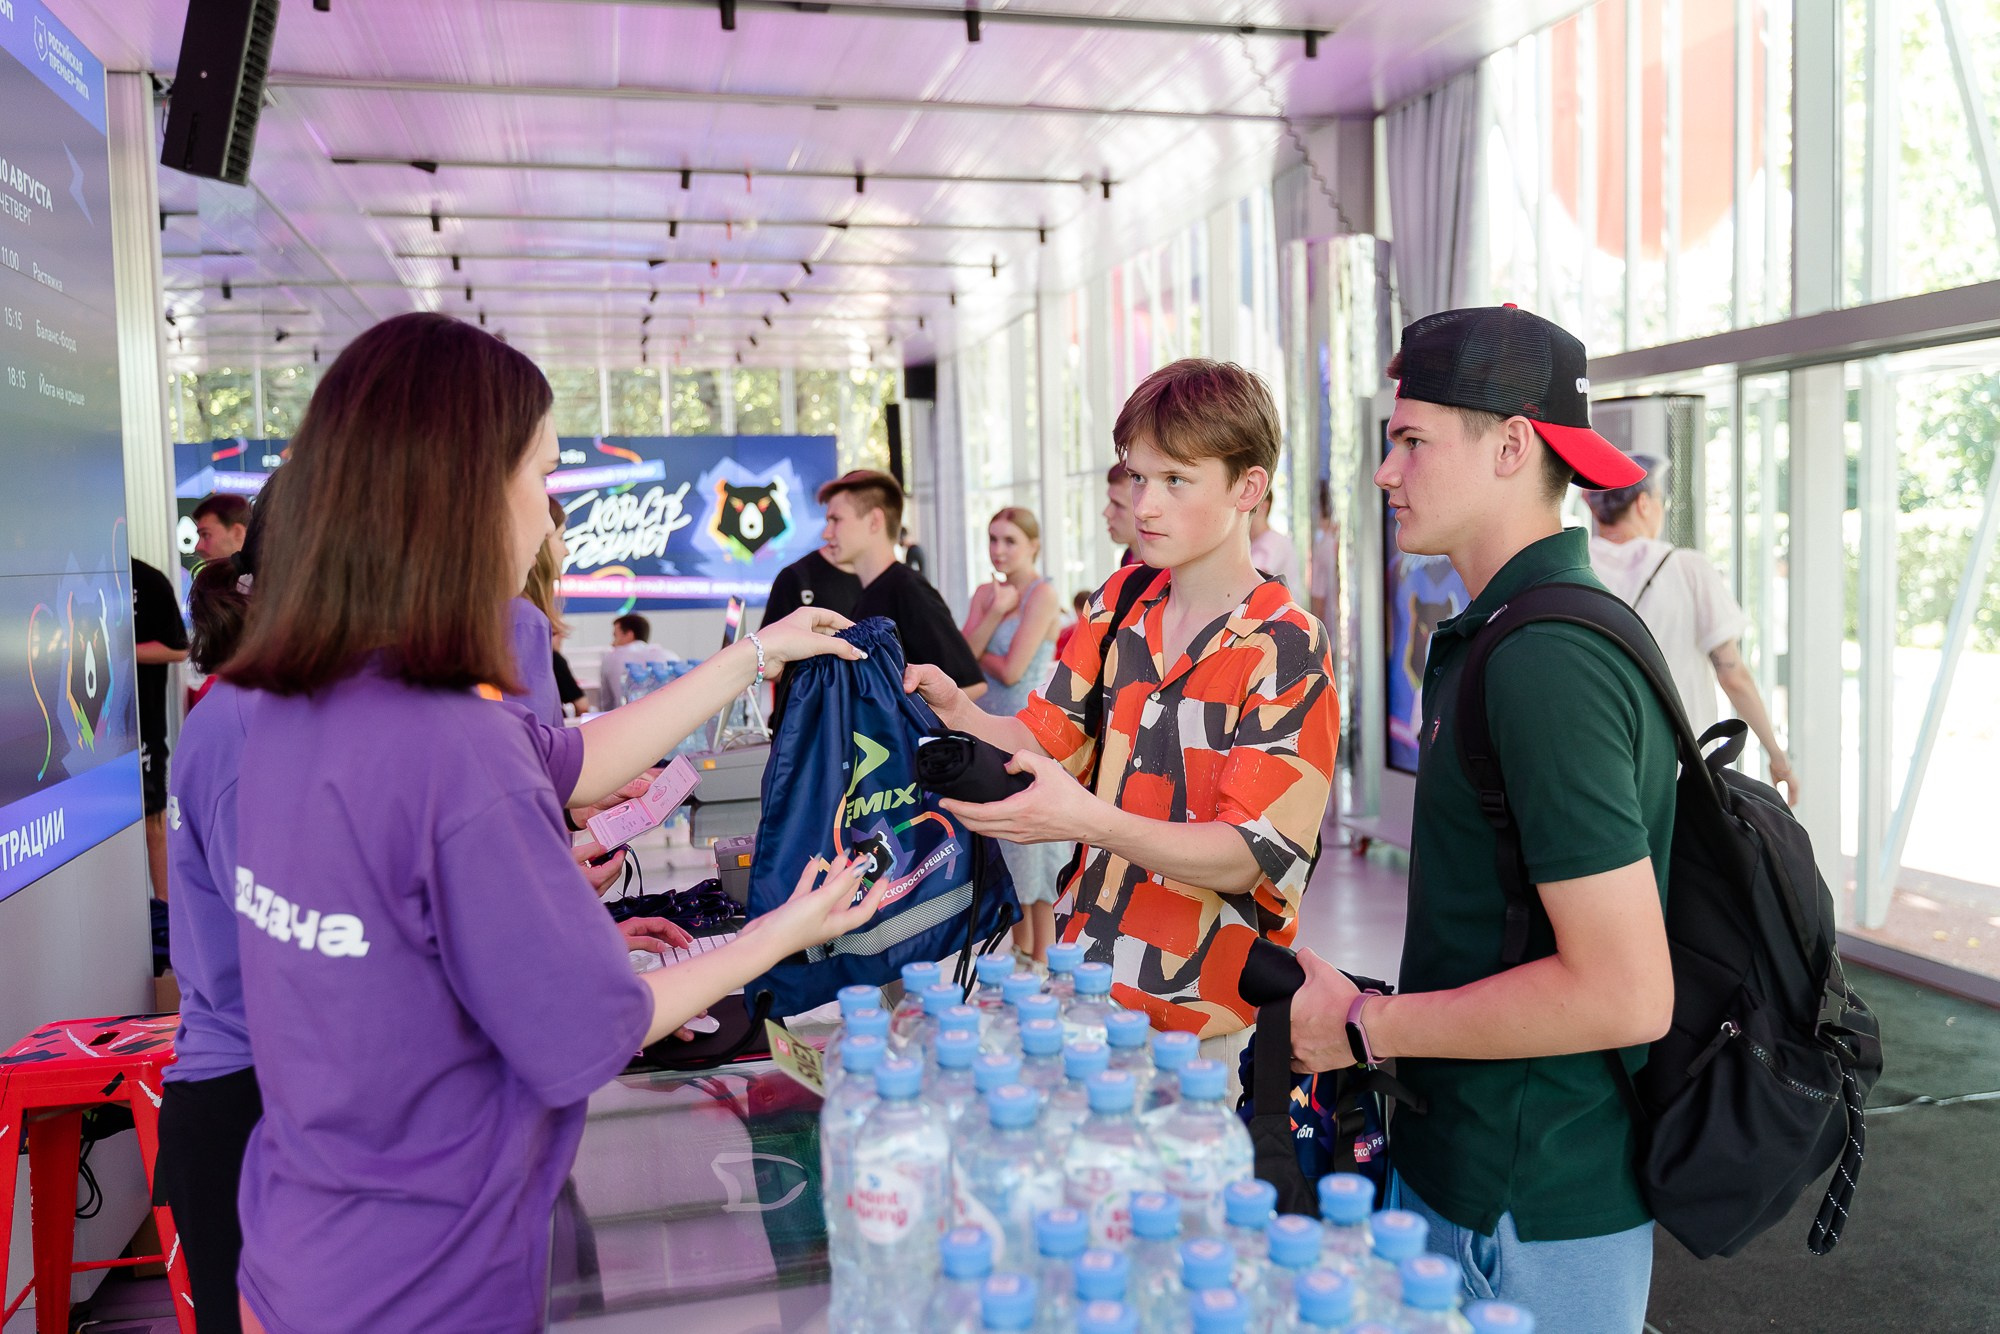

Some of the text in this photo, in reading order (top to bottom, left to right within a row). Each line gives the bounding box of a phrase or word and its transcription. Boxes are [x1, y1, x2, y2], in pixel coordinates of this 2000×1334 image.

[47, 30, 84, 77] РОССИЙСКАЯ
[0, 191, 32, 226] ЧЕТВЕРГ
[10, 165, 54, 212] АВГУСТА
[32, 262, 63, 292] Растяжка
[4, 306, 78, 353] 15:15 Баланс-борд
[7, 366, 27, 390] 18:15
[38, 372, 56, 397] Йога
[65, 388, 86, 406] крыше
[924, 843, 956, 870] РЕШАЕТ
